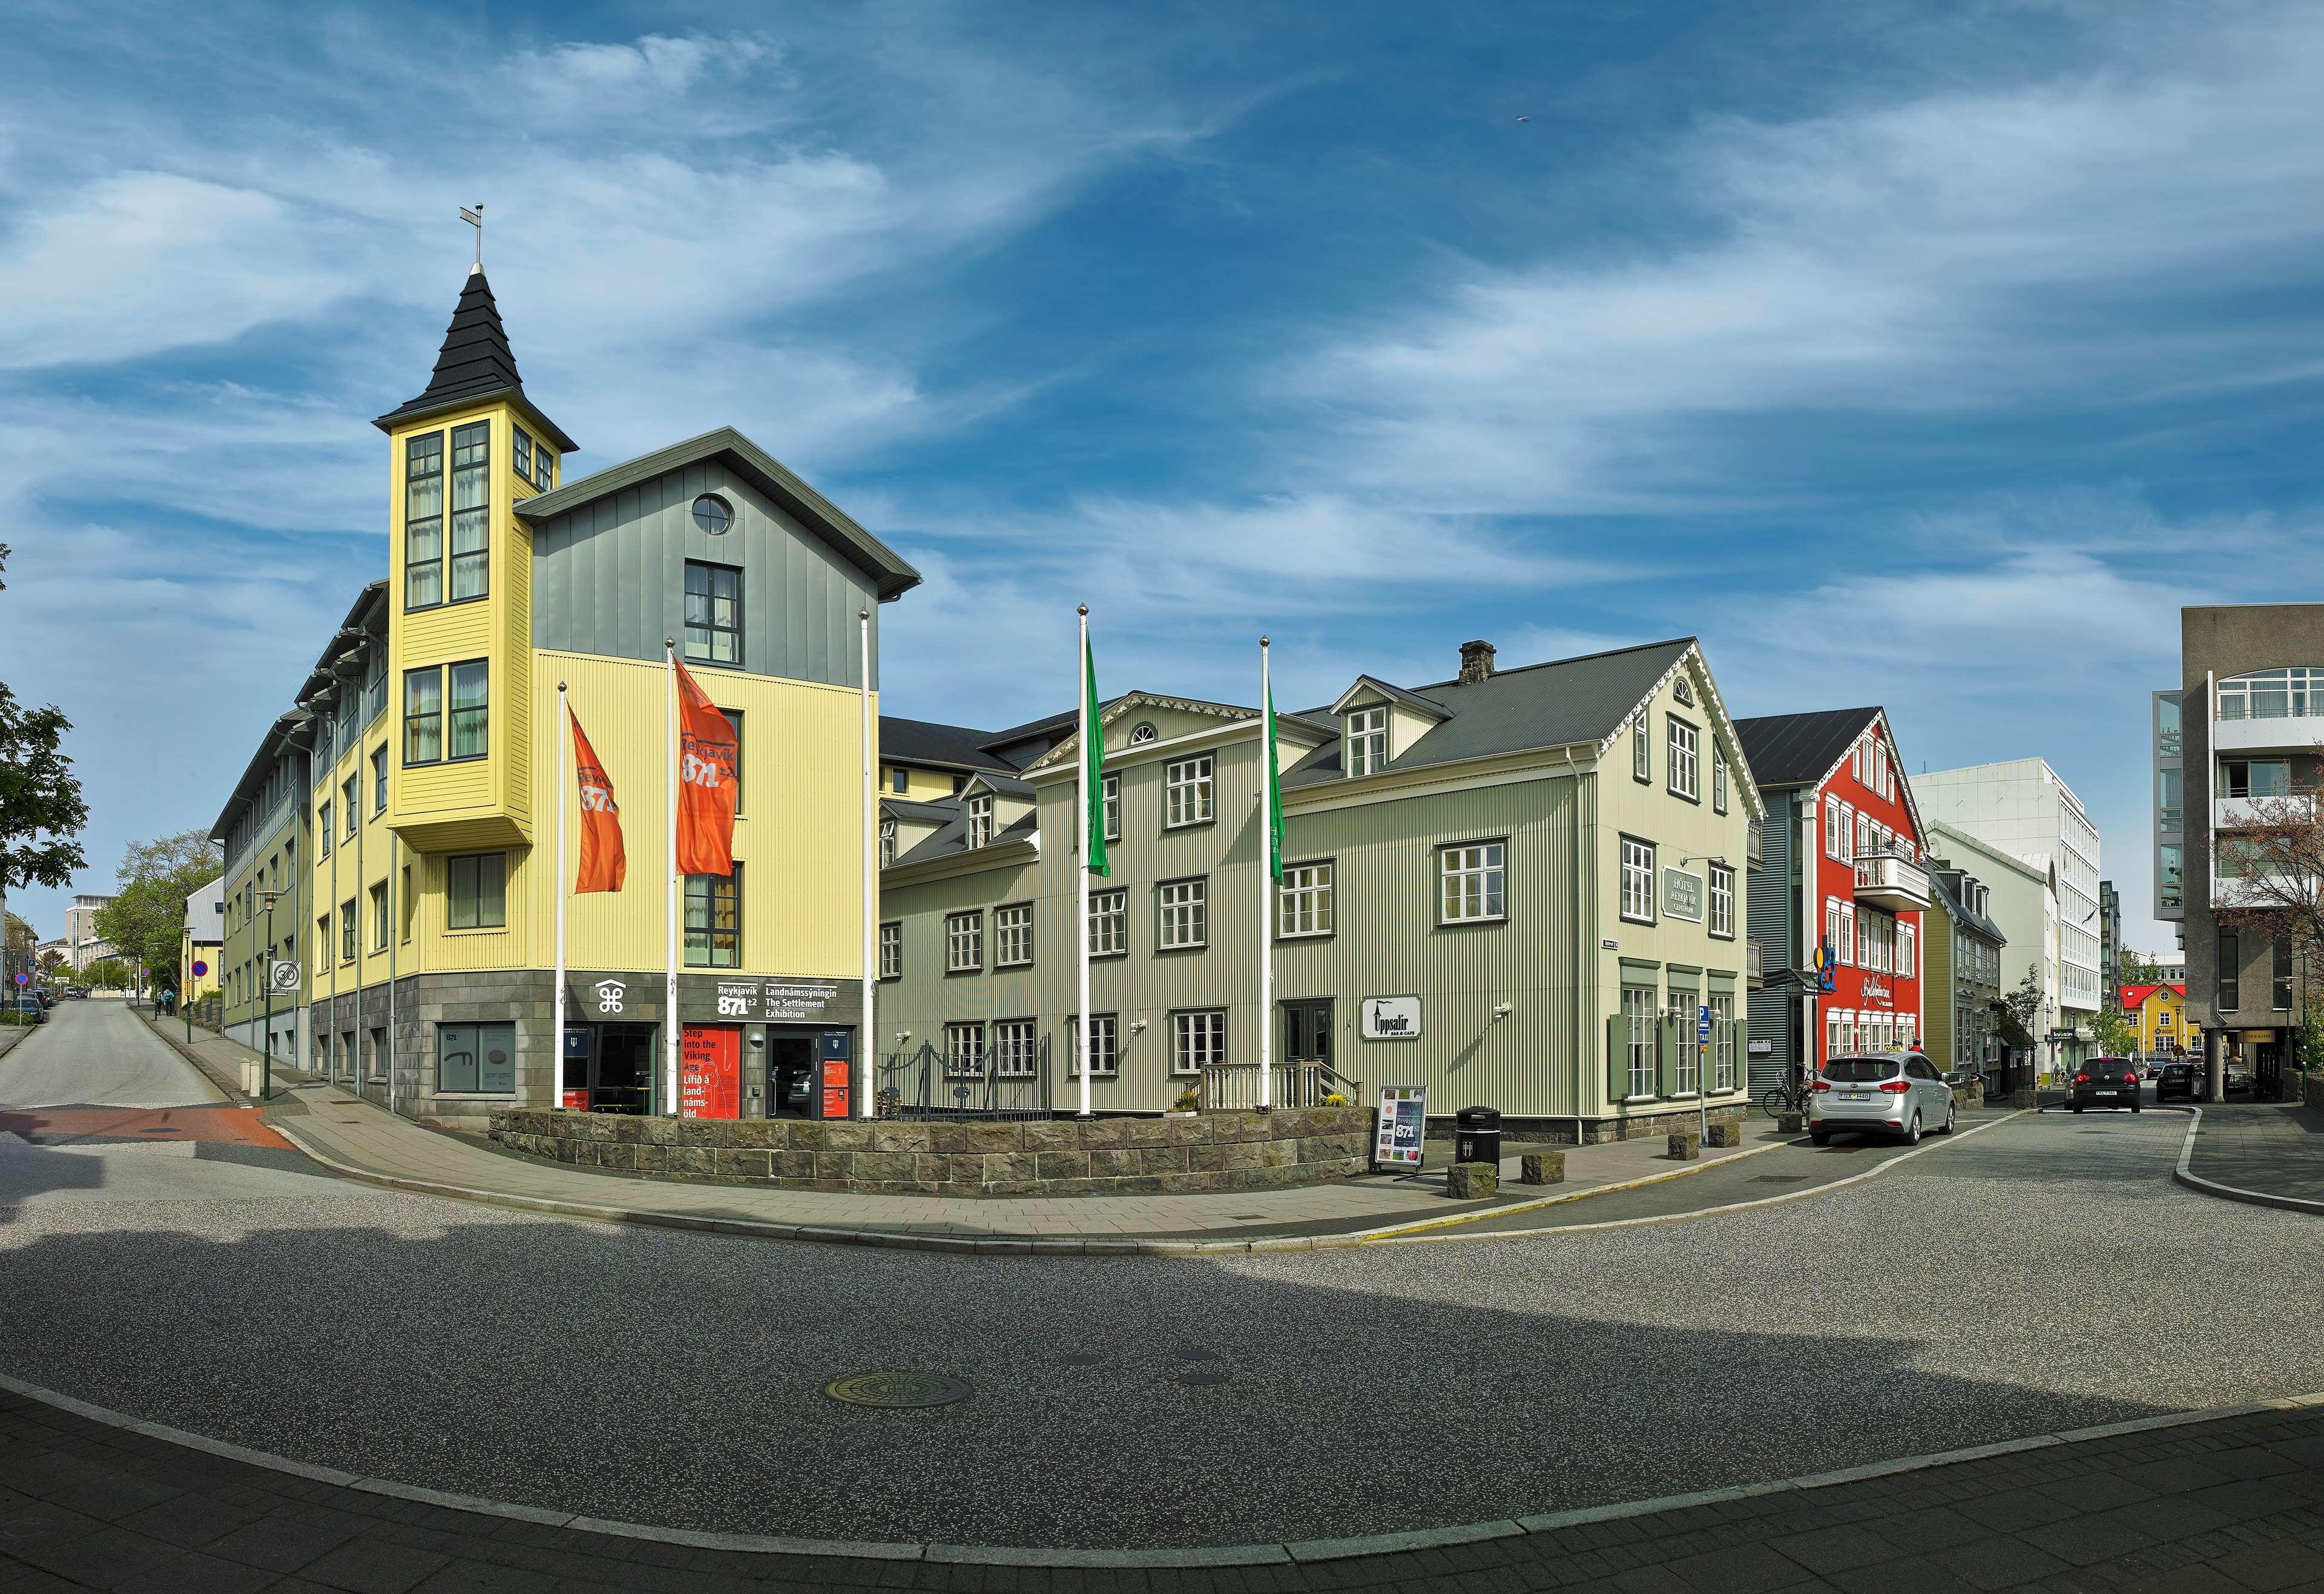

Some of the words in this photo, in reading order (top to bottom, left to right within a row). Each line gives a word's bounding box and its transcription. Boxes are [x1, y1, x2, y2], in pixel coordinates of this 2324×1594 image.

[682, 754, 720, 788] 871
[1674, 877, 1694, 893] HÓTEL
[1671, 891, 1696, 906] REYKJAVÍK
[1673, 903, 1694, 914] CENTRUM
[718, 986, 757, 996] Reykjavík
[766, 987, 837, 999] Landnámssýningin
[783, 999, 825, 1008] Settlement
[766, 1010, 805, 1018] Exhibition
[1699, 1007, 1705, 1021] P
[1375, 1014, 1408, 1035] Uppsalir
[684, 1029, 703, 1039] Step
[684, 1040, 700, 1049] into
[703, 1040, 716, 1049] the
[684, 1051, 711, 1062] Viking
[684, 1062, 700, 1073] Age
[683, 1075, 702, 1084] Lífið
[704, 1075, 709, 1084] á
[683, 1086, 705, 1096] land-
[683, 1097, 708, 1107] náms-
[683, 1108, 697, 1118] öld
[1395, 1124, 1414, 1138] 871
